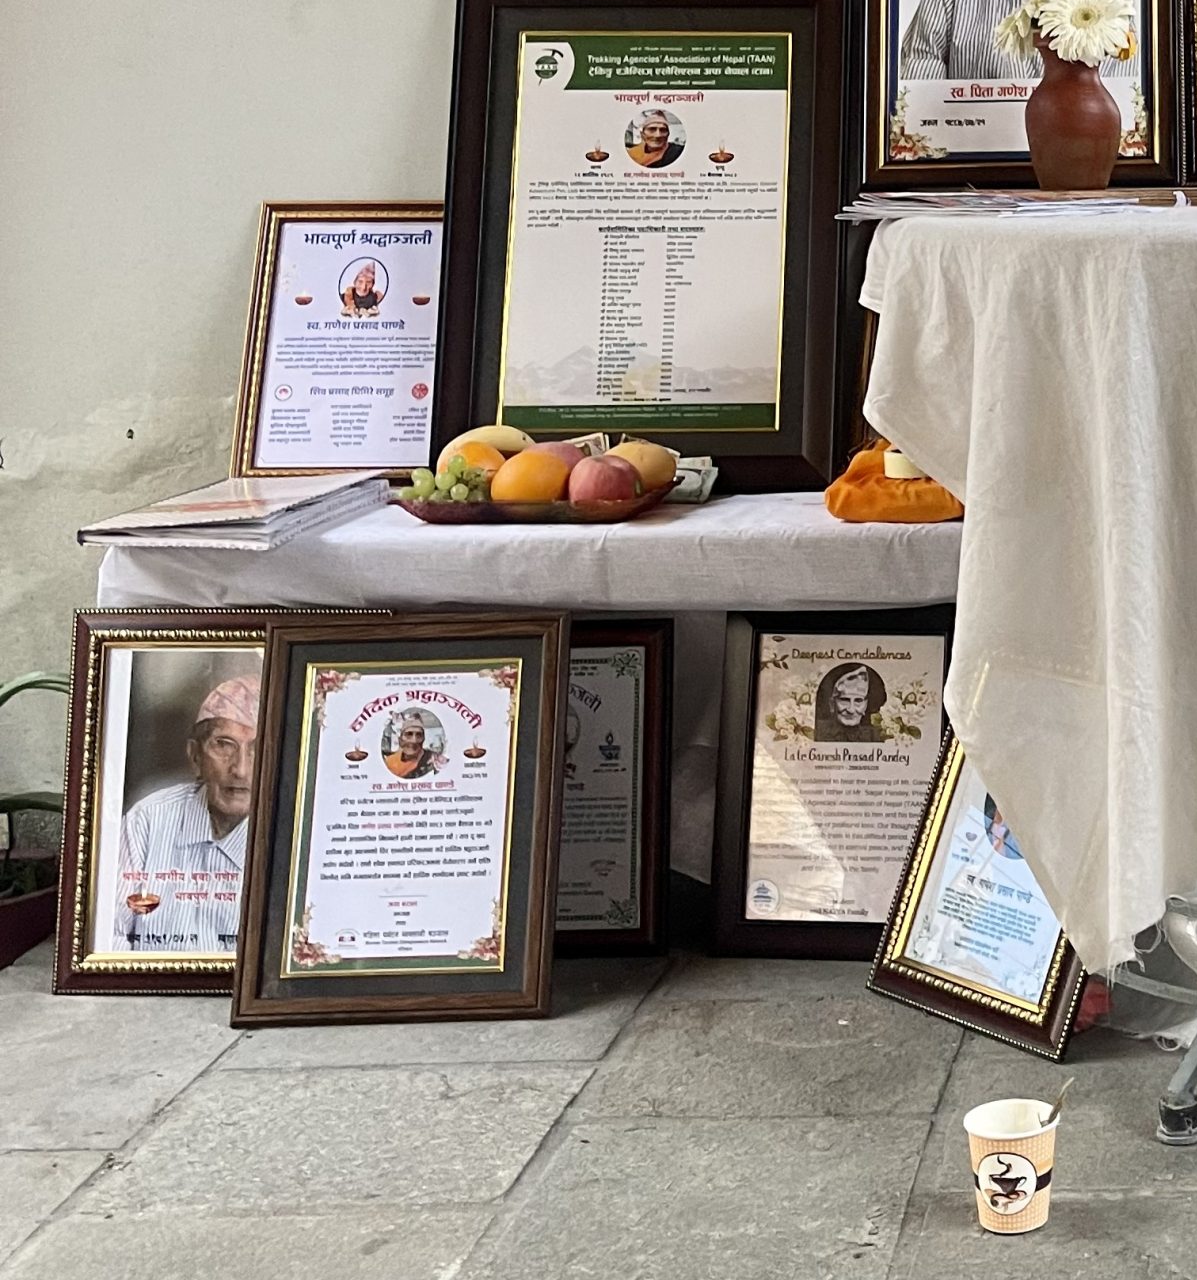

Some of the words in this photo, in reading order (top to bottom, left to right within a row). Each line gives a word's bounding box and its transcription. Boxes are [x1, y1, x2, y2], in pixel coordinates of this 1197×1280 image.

[663, 54, 711, 64] Association
[712, 54, 721, 63] of
[722, 54, 746, 65] Nepal
[747, 54, 776, 65] (TAAN)
[614, 91, 650, 105] भावपूर्ण
[970, 83, 993, 98] पिता
[997, 83, 1028, 97] गणेश
[304, 229, 356, 250] भावपूर्ण
[324, 319, 350, 331] गणेश
[353, 320, 379, 331] प्रसाद
[382, 319, 405, 331] पाण्डे
[791, 648, 835, 662] Deepest
[836, 646, 912, 660] Condolences
[350, 693, 399, 733] हार्दिक
[784, 747, 806, 761] Late
[808, 748, 842, 761] Ganesh
[842, 748, 875, 761] Prasad
[876, 748, 910, 765] Pandey
[214, 870, 239, 881] गणेश
